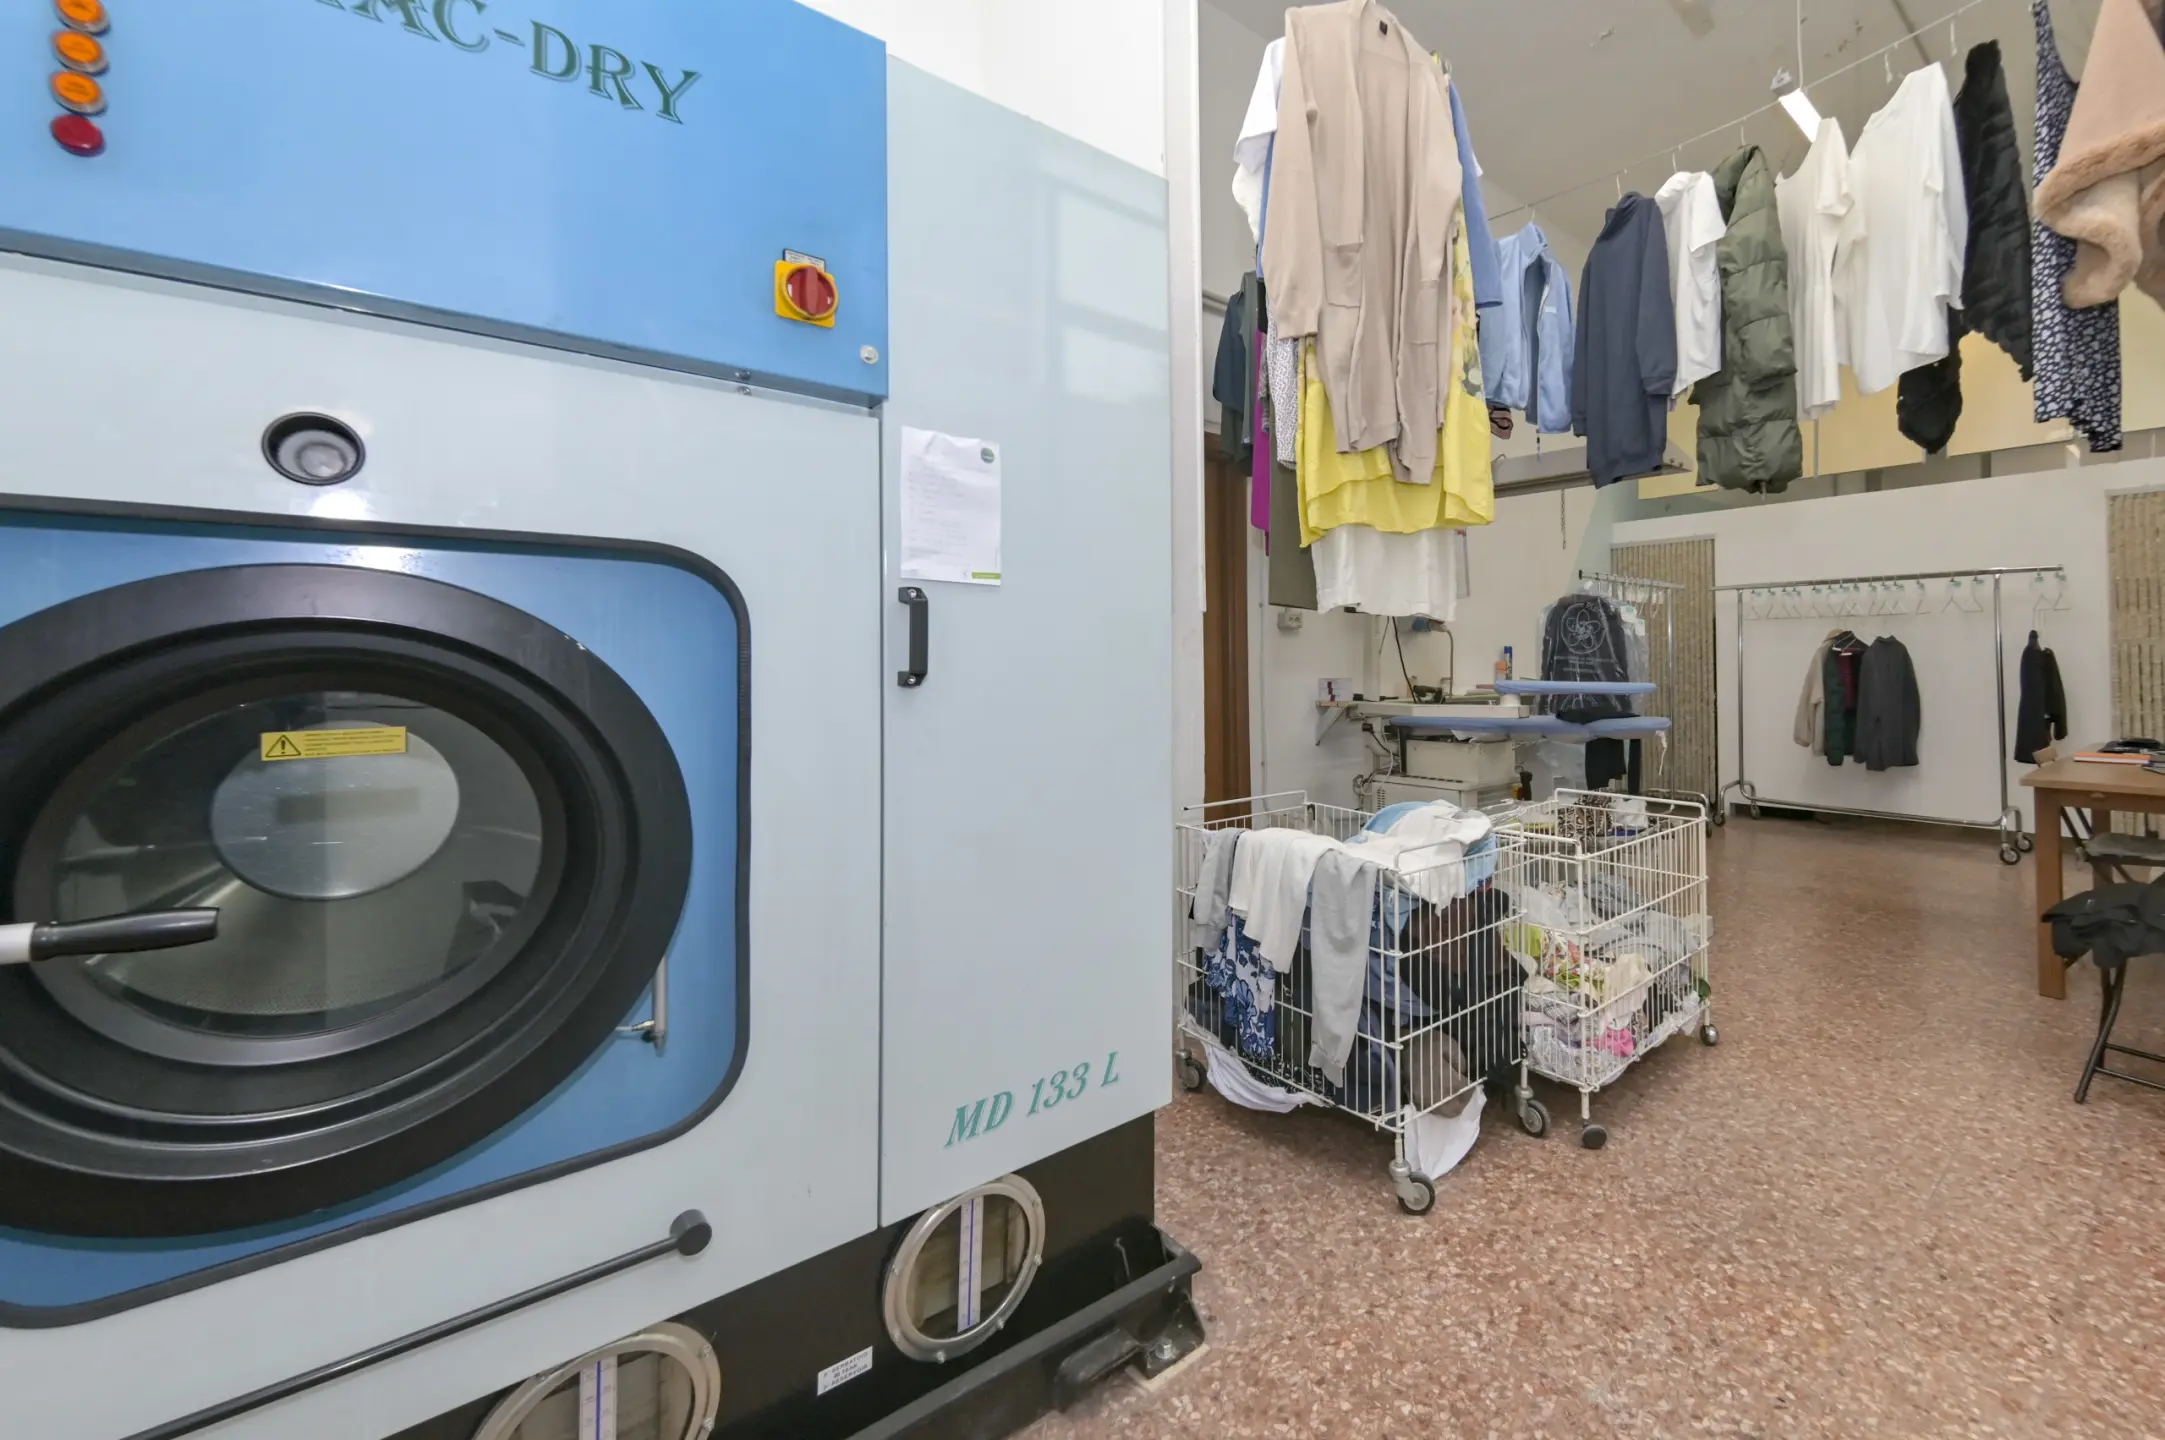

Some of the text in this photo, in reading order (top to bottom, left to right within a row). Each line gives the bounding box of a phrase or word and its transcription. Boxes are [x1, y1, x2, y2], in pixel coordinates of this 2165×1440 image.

[315, 0, 702, 125] AC-DRY
[943, 1050, 1120, 1148] MD 133 L
